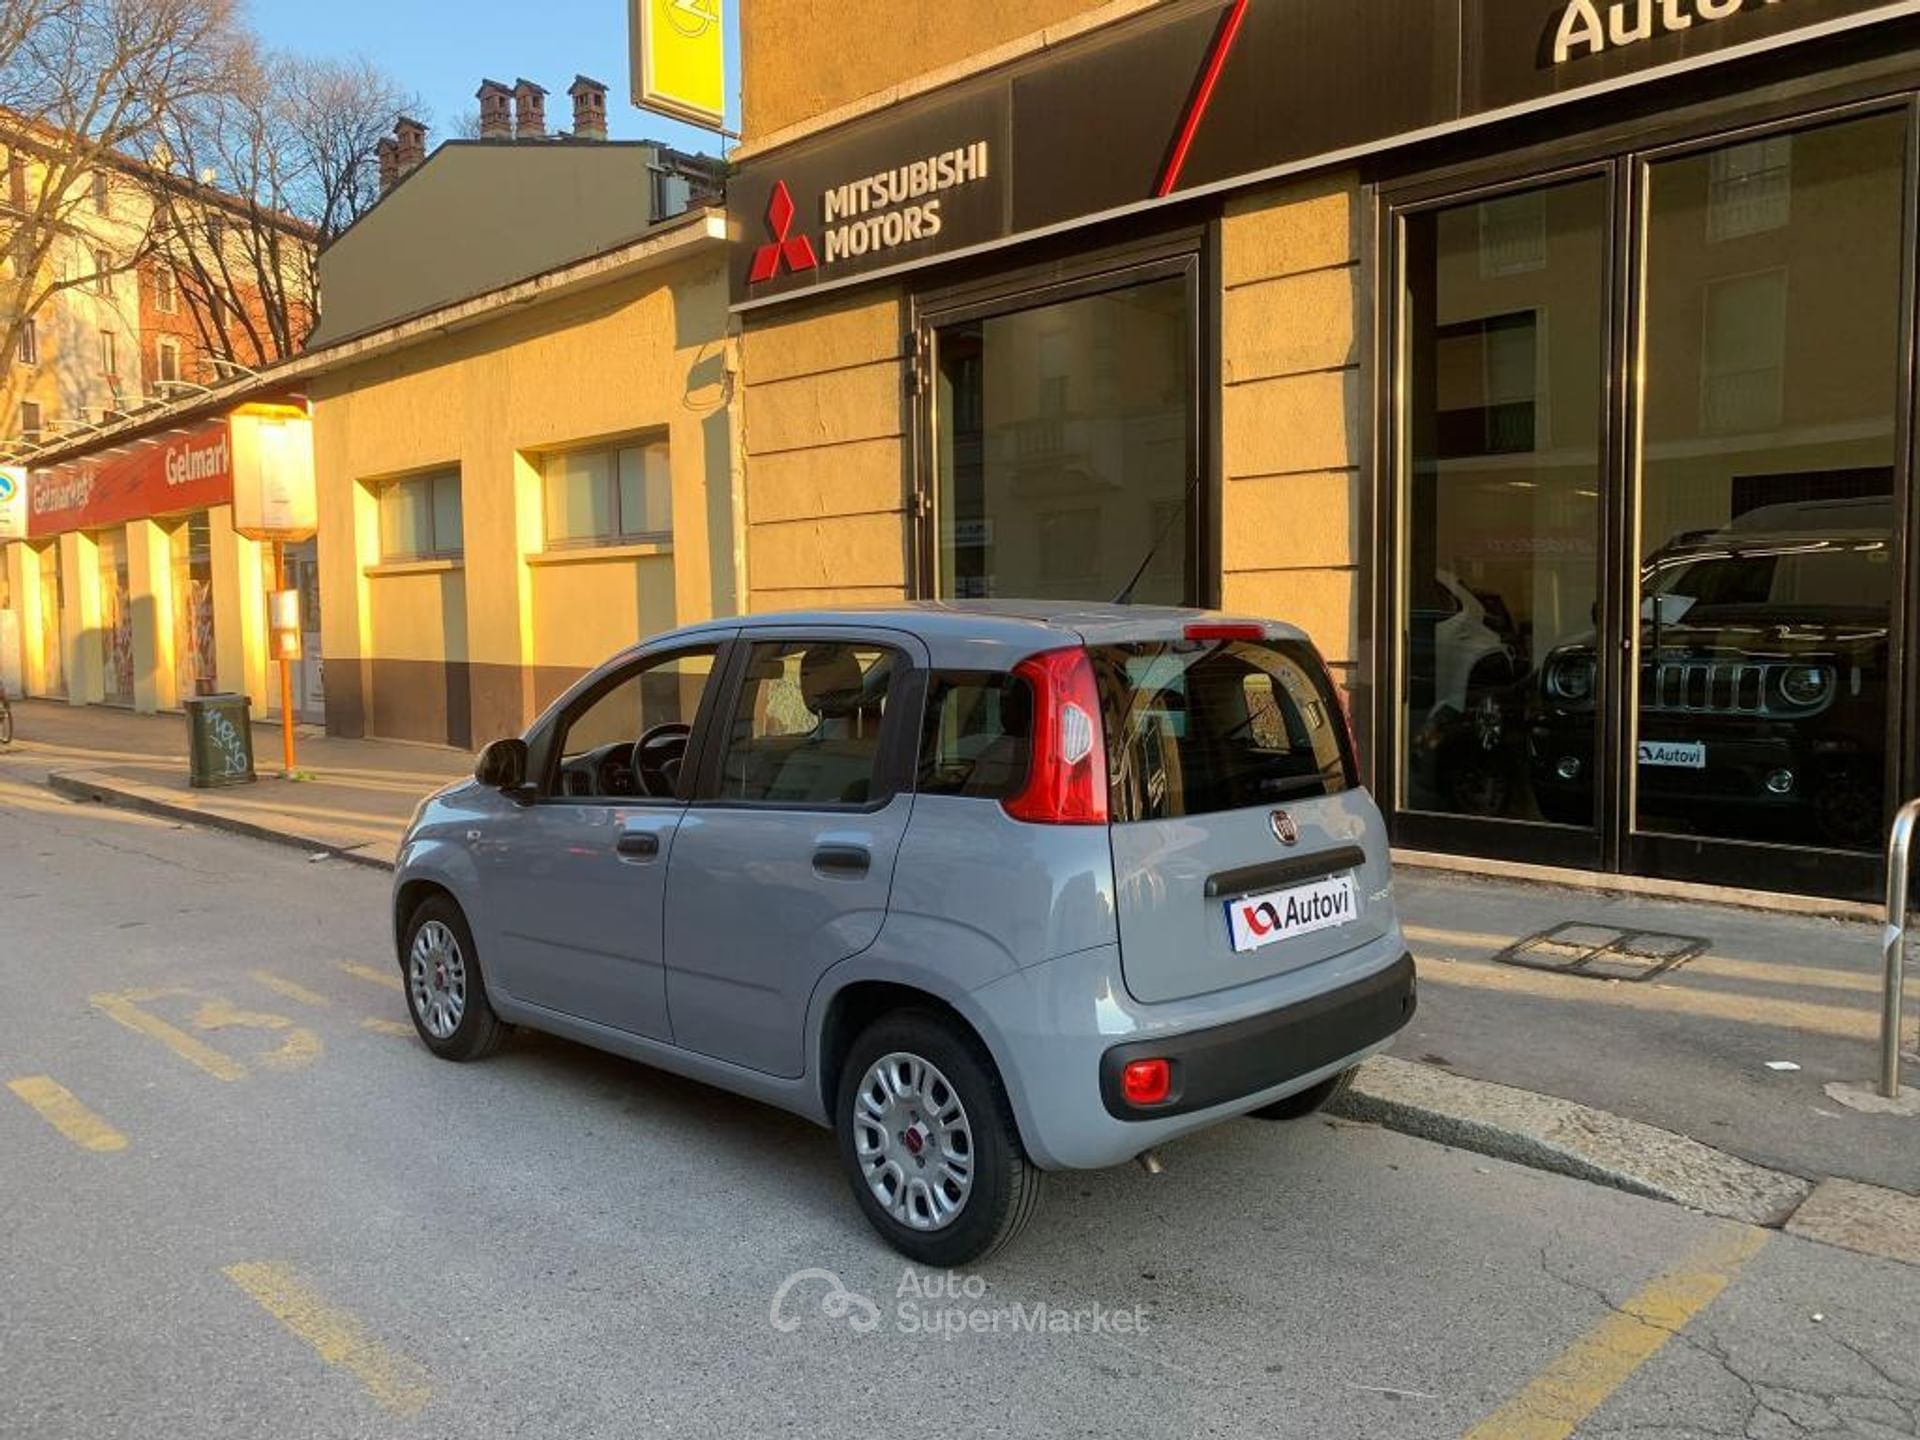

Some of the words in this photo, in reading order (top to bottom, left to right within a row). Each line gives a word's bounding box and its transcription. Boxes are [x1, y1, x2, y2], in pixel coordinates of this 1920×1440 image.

[1553, 0, 1780, 63] Auto
[824, 140, 988, 223] MITSUBISHI
[824, 200, 942, 263] MOTORS
[1284, 883, 1350, 929] Autovì
